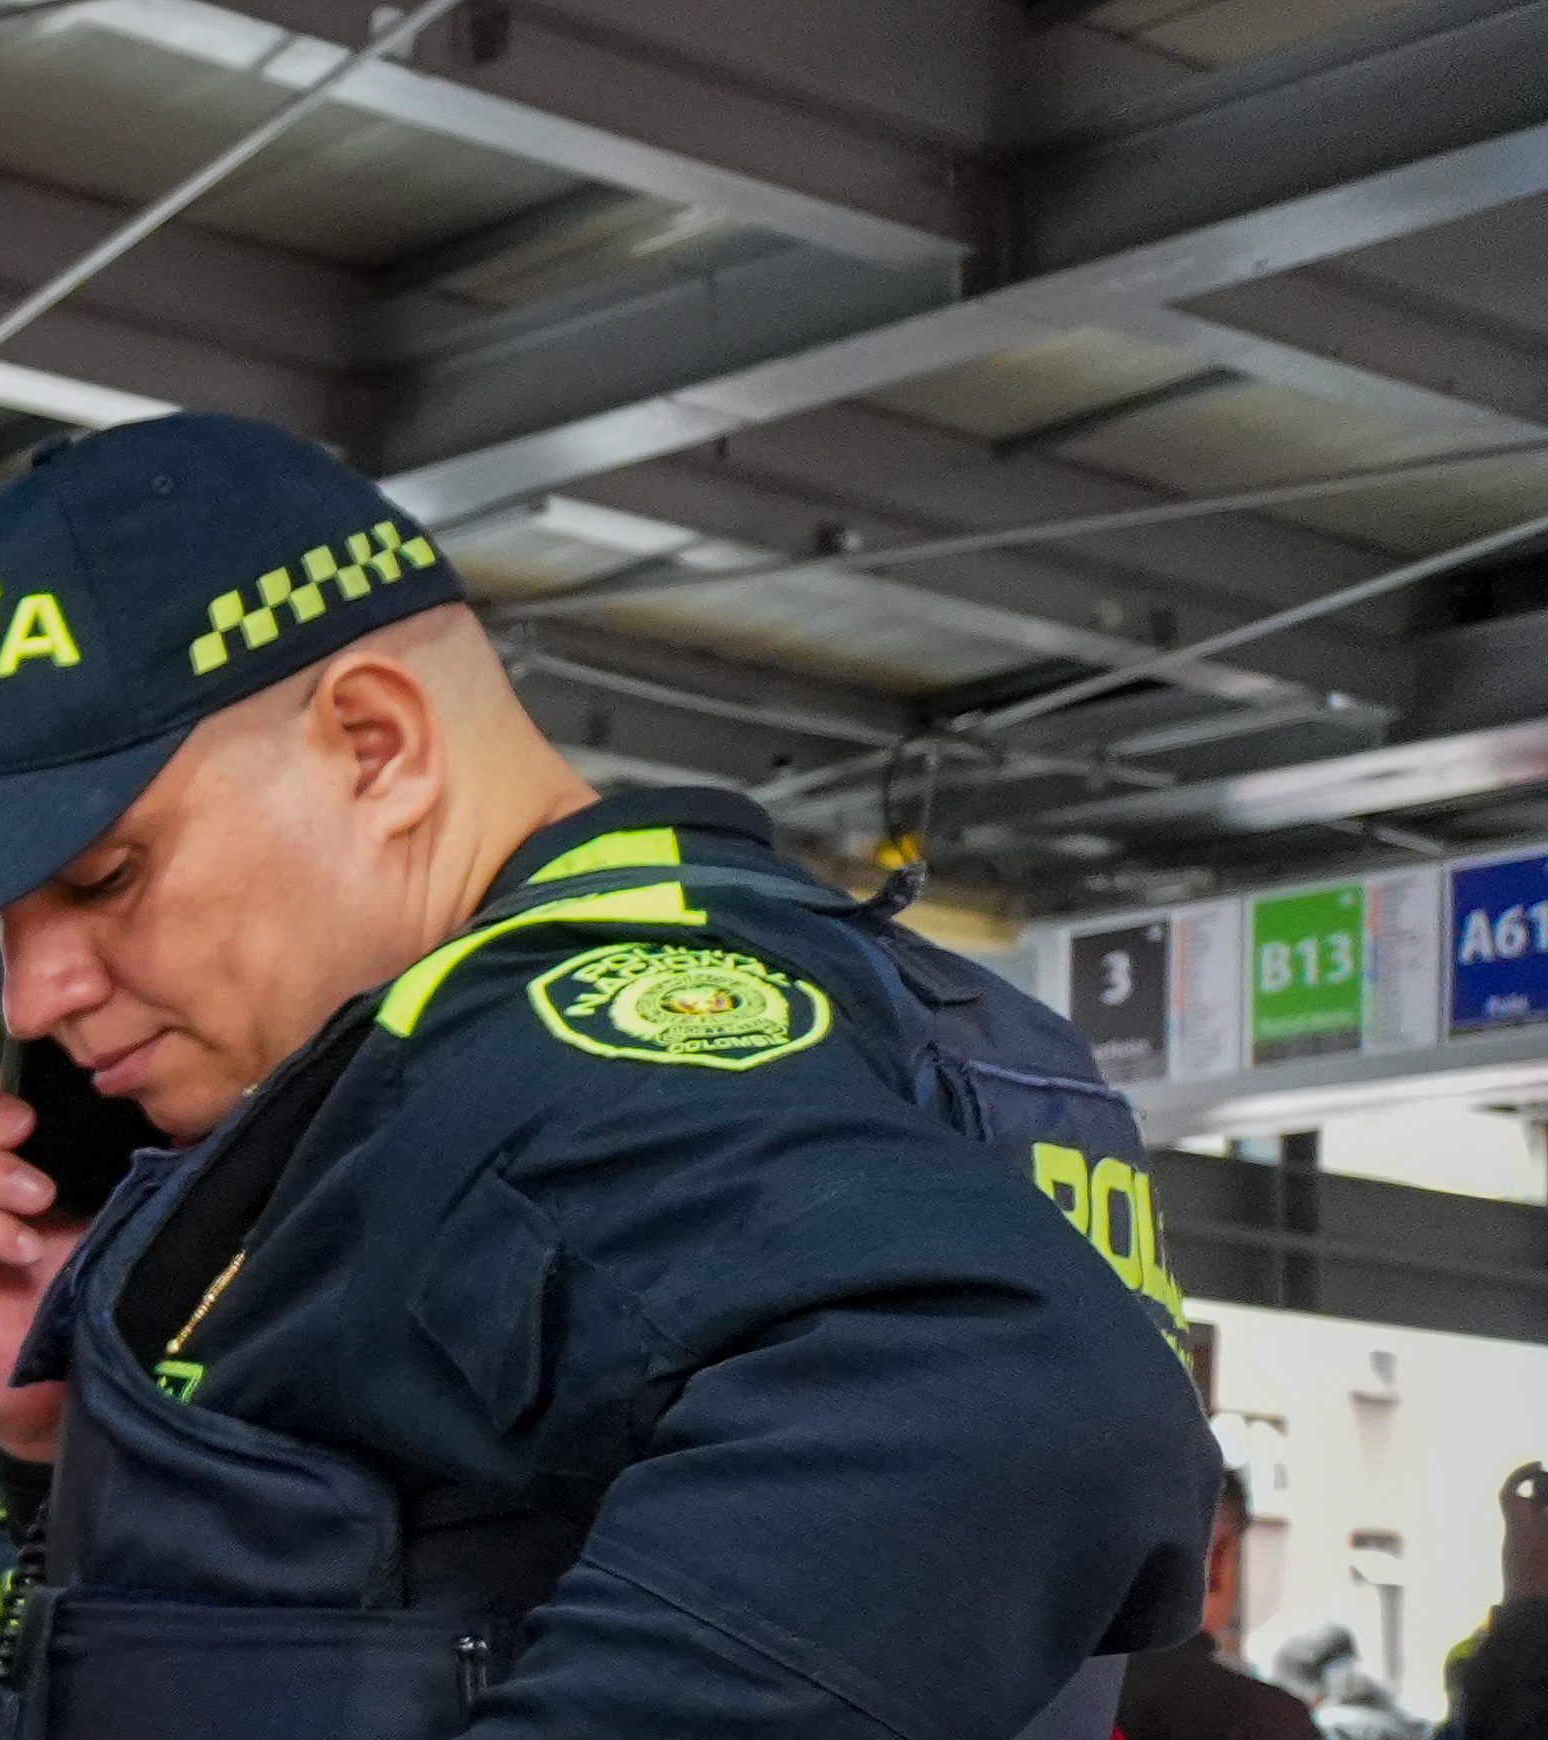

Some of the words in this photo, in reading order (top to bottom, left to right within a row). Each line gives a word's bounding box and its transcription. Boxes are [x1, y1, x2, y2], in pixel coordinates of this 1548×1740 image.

[1459, 900, 1548, 964] A61
[1099, 949, 1133, 1006] 3
[1258, 933, 1354, 994] B13
